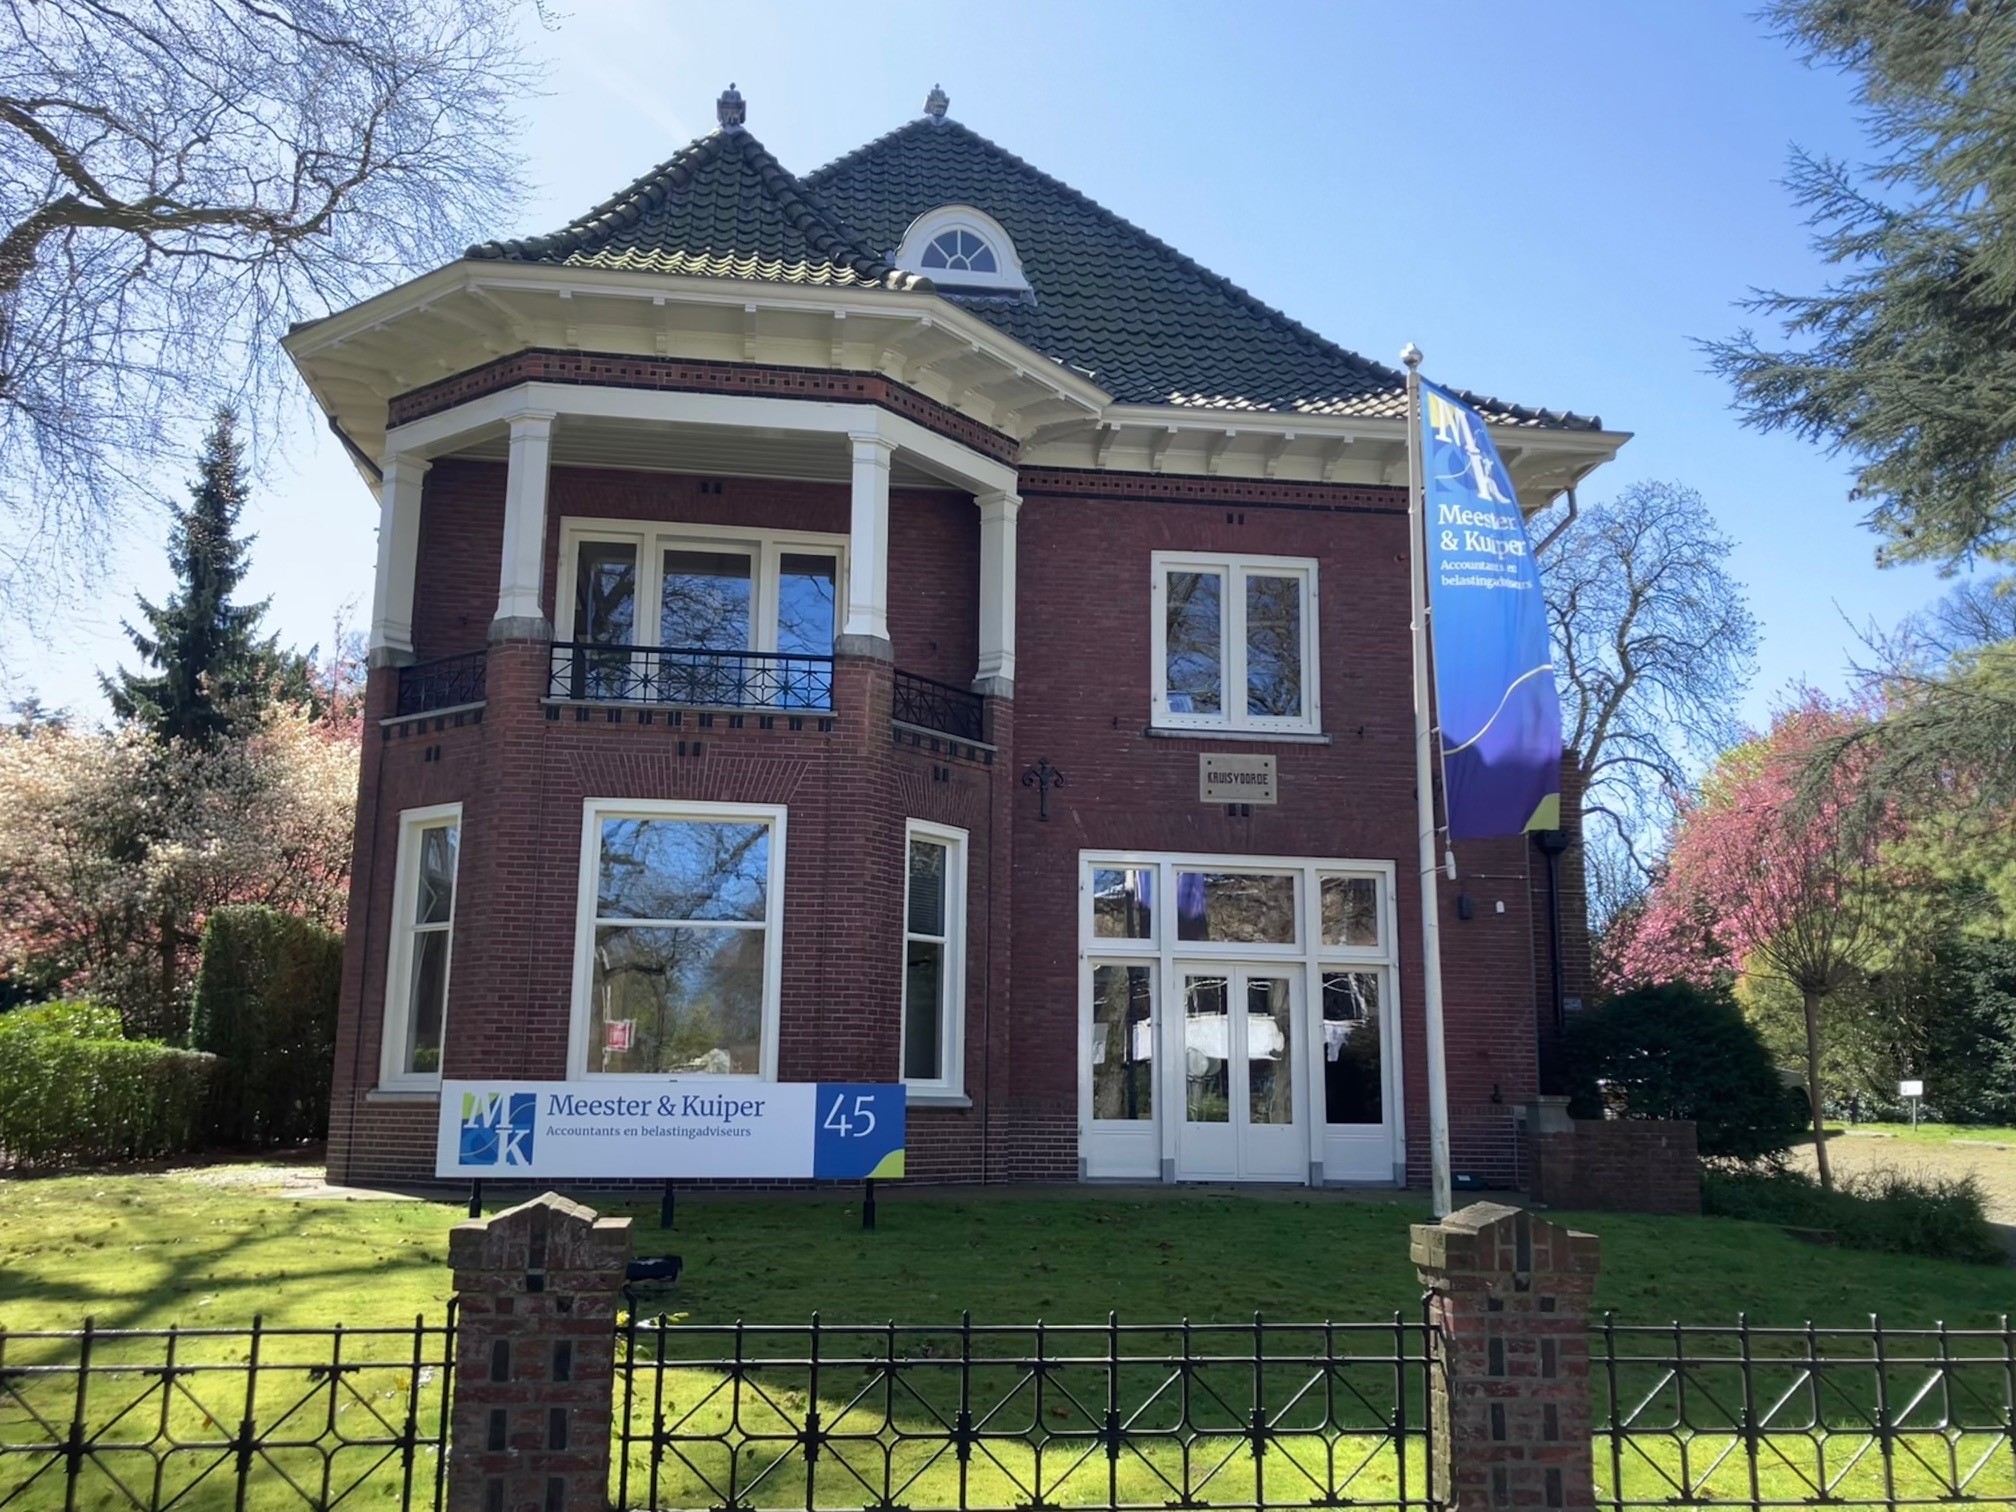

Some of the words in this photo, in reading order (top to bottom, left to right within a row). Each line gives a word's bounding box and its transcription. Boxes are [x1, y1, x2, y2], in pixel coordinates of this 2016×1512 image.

[1437, 503, 1518, 531] Meester
[1440, 529, 1460, 551] &
[1463, 530, 1527, 561] Kuiper
[1440, 574, 1534, 591] belastingadeurs
[463, 1092, 514, 1129] M
[547, 1093, 653, 1116] Meester
[657, 1095, 677, 1117] &
[681, 1094, 766, 1123] Kuiper
[823, 1093, 876, 1138] 45
[494, 1129, 532, 1166] K
[546, 1125, 622, 1137] Accountants
[623, 1127, 639, 1137] en
[641, 1125, 752, 1140] belastingadviseurs
